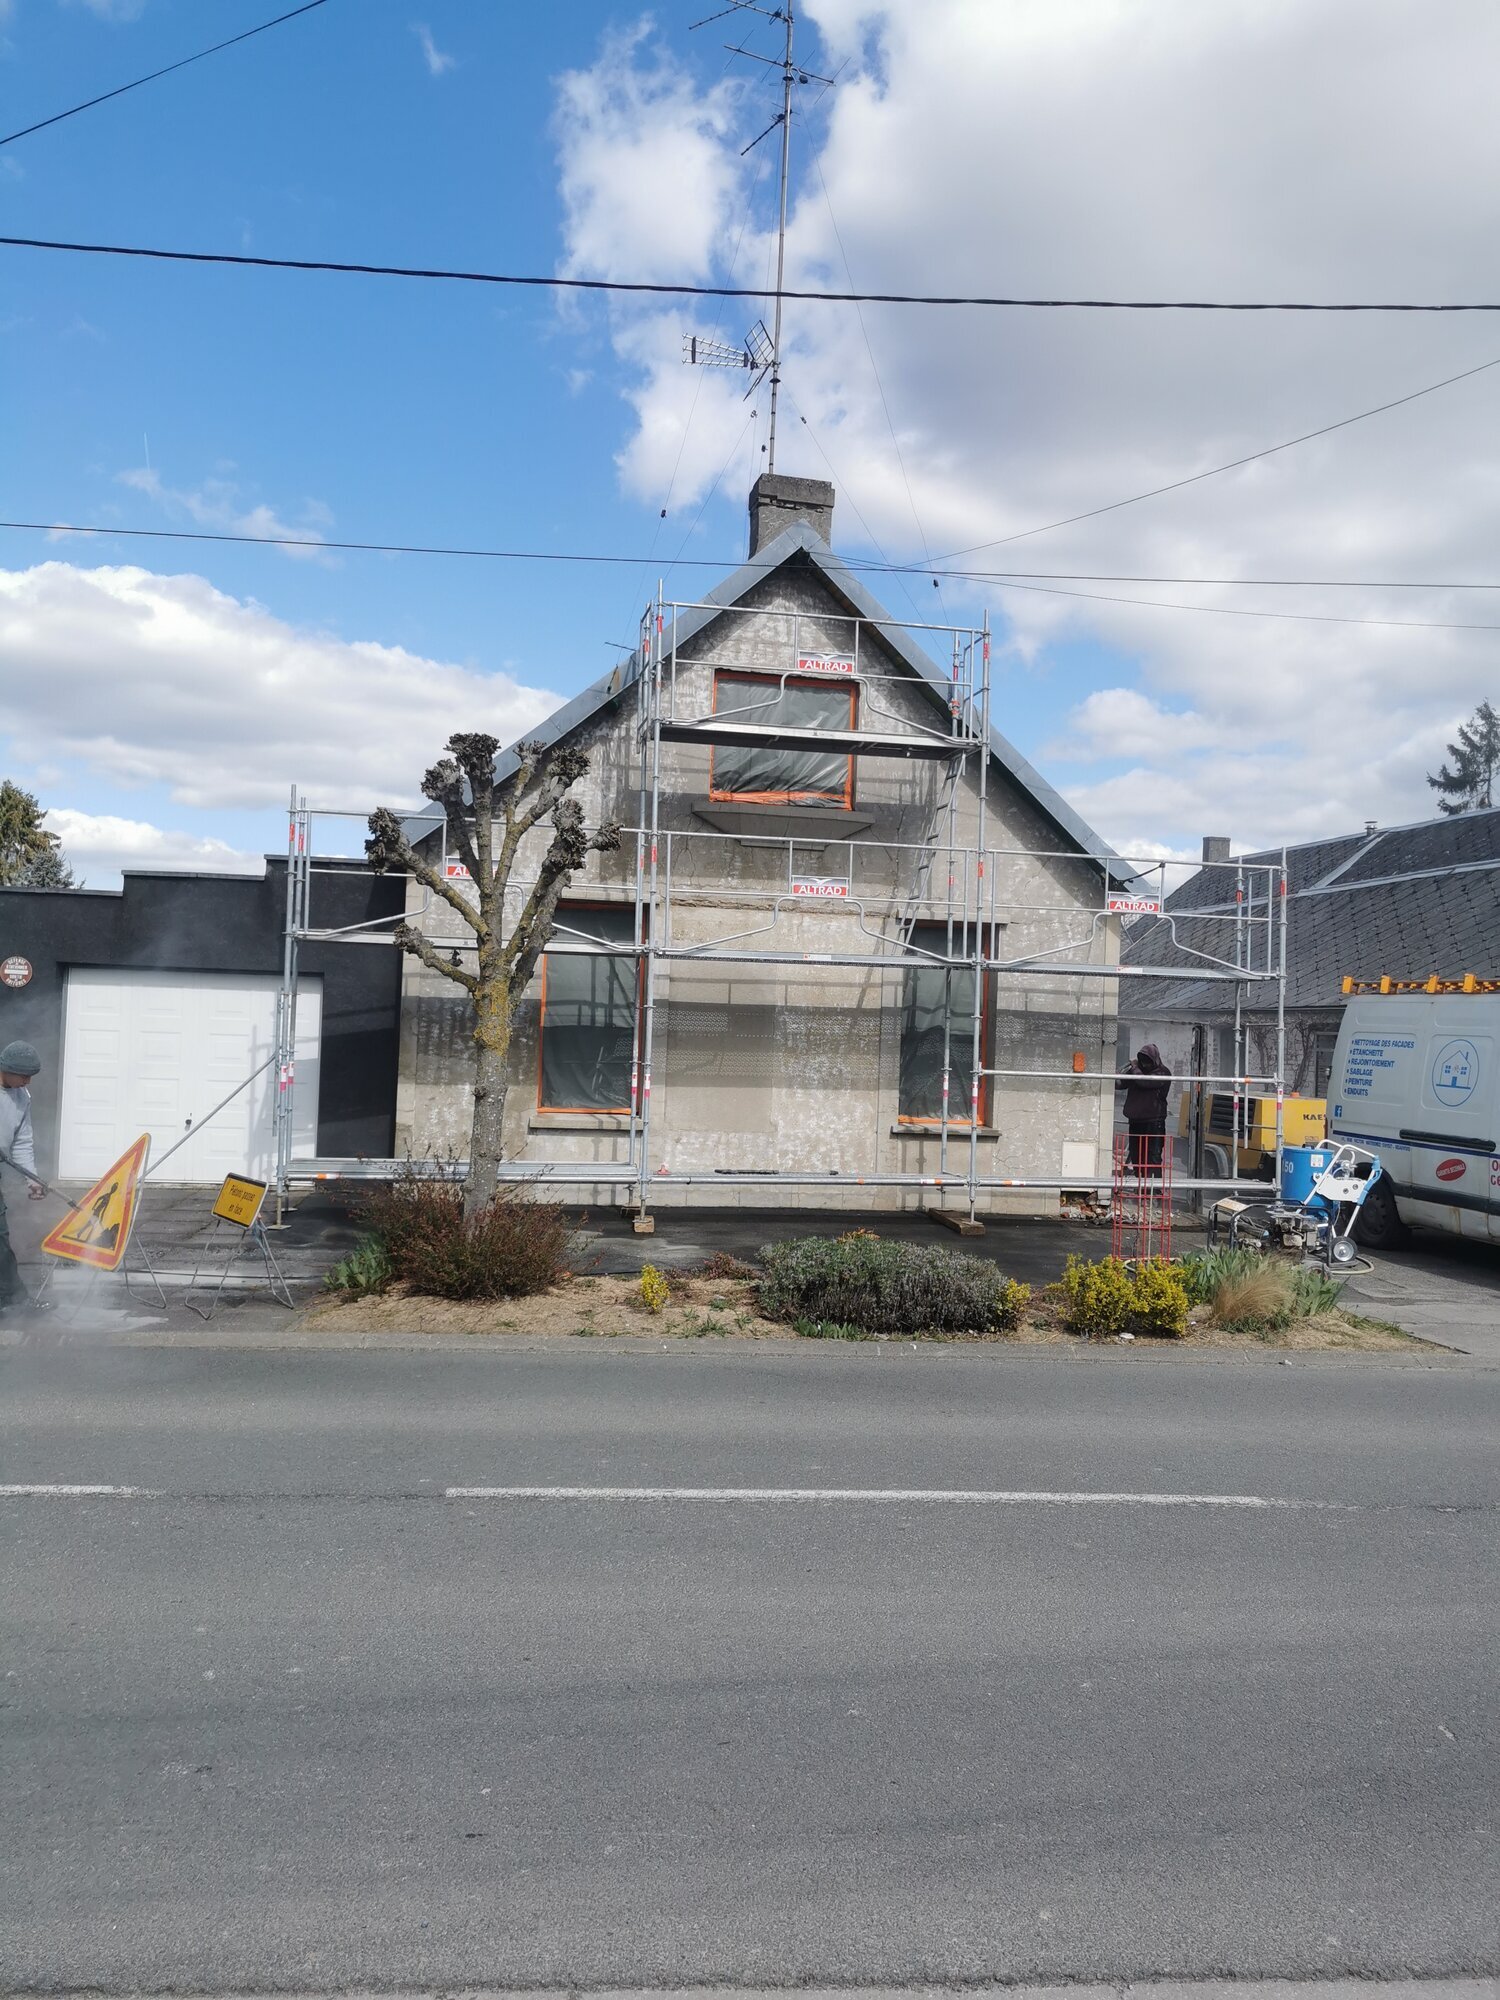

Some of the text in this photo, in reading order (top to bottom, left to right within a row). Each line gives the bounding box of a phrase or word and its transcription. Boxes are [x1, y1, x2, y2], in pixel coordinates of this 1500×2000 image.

[804, 660, 849, 672] ALTRAD
[798, 885, 843, 896] ALTRAD
[1114, 901, 1155, 911] ALTRAD
[1354, 1039, 1380, 1047] NETTOYAGE
[1381, 1040, 1391, 1048] DES
[1350, 1068, 1373, 1077] SABLAGE
[1348, 1077, 1373, 1087] PEINTURE
[1347, 1087, 1369, 1097] ENDUITS
